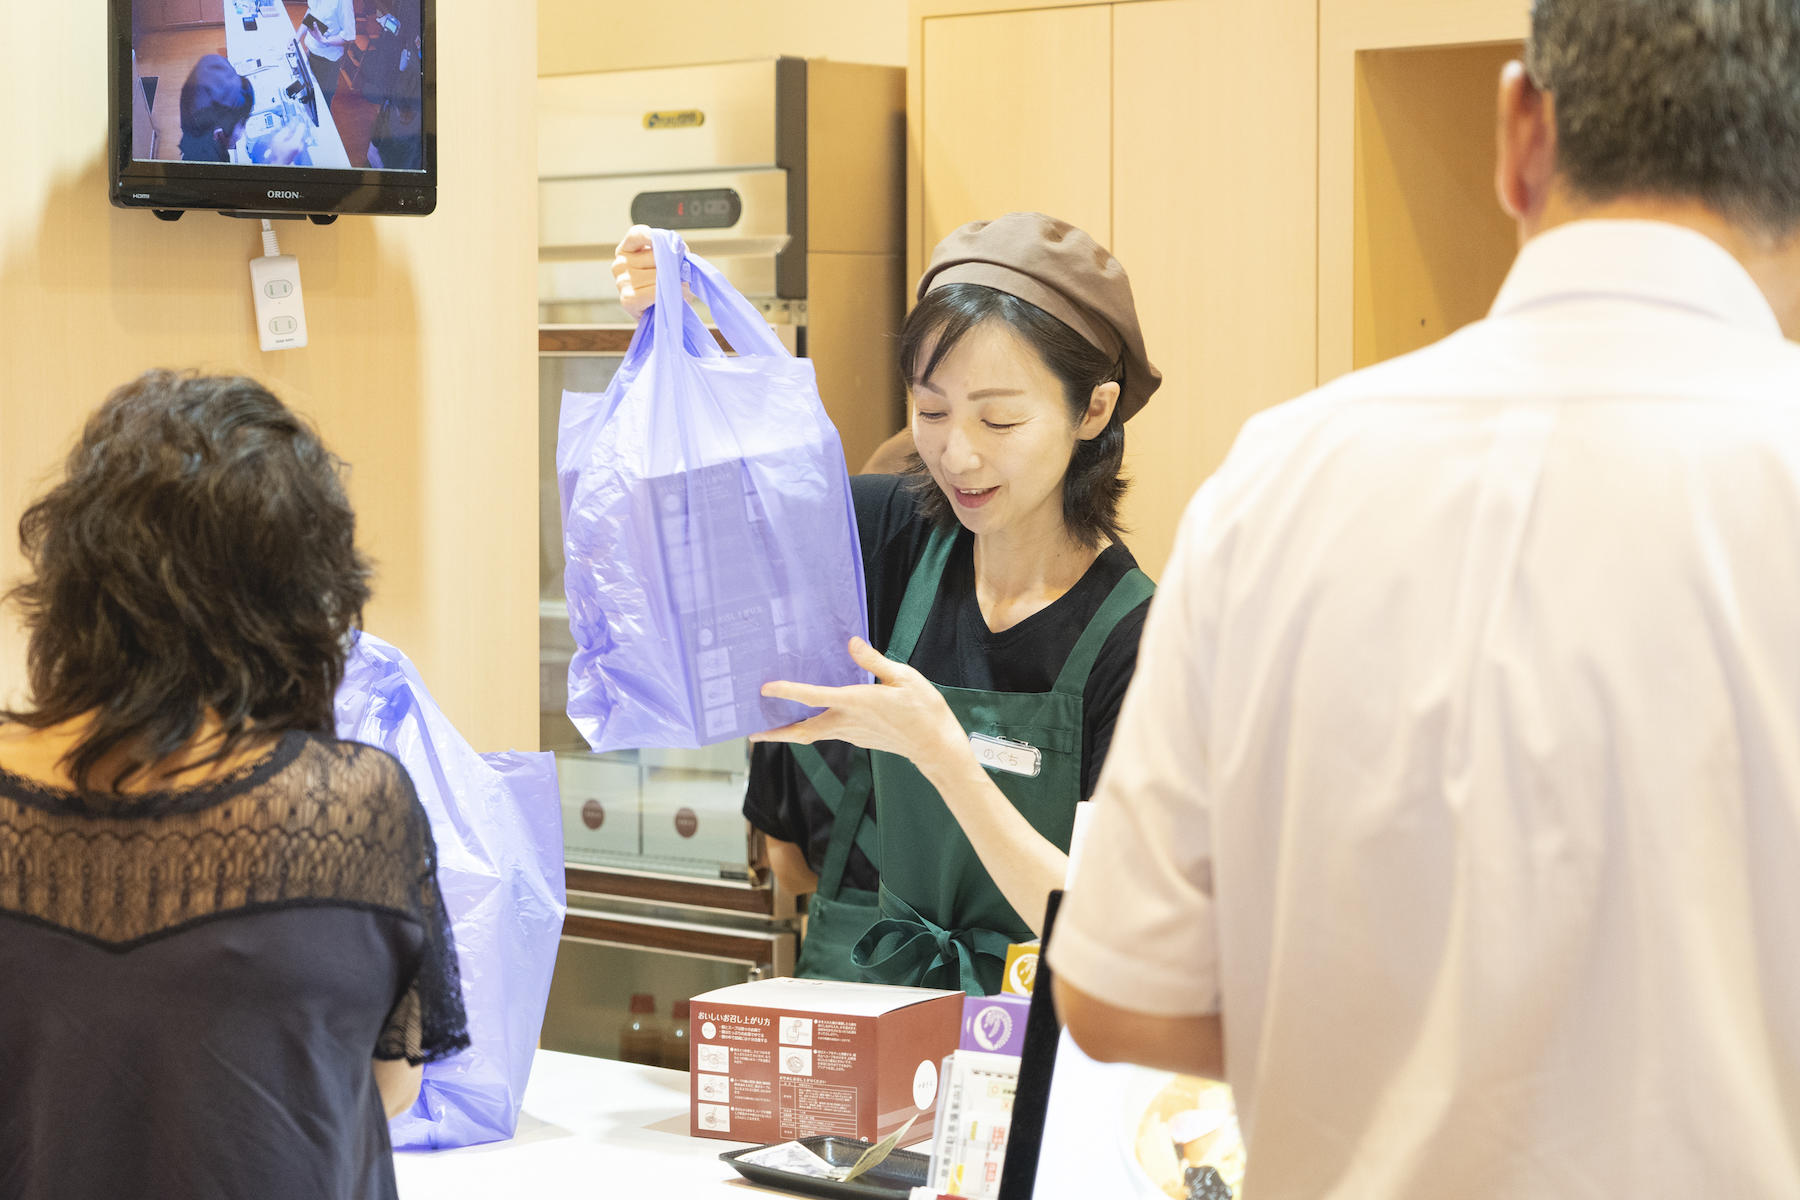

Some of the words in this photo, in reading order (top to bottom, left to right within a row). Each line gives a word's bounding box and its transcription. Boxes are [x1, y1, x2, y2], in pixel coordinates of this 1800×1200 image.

[267, 190, 299, 199] ORION
[698, 1012, 771, 1026] おいしいお召し上がり方
